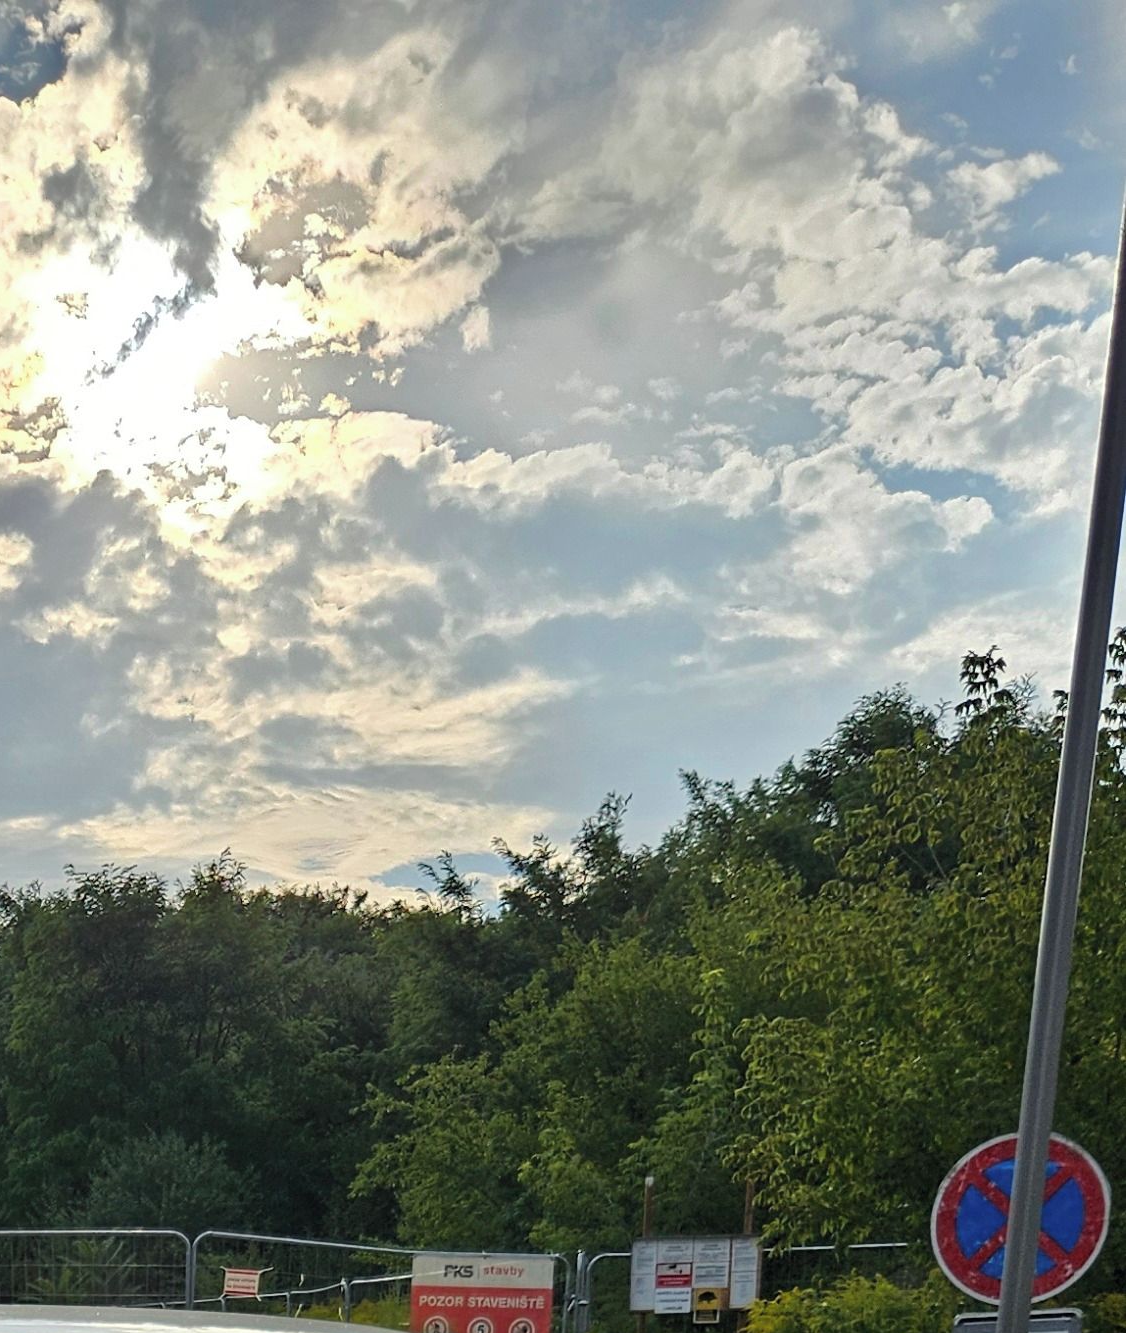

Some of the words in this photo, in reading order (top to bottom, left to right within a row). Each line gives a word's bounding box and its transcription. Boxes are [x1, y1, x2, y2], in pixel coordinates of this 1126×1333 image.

[443, 1264, 474, 1278] PKS
[483, 1265, 525, 1277] stavby
[419, 1295, 464, 1307] POZOR
[467, 1295, 545, 1309] STAVENIŠTĚ
